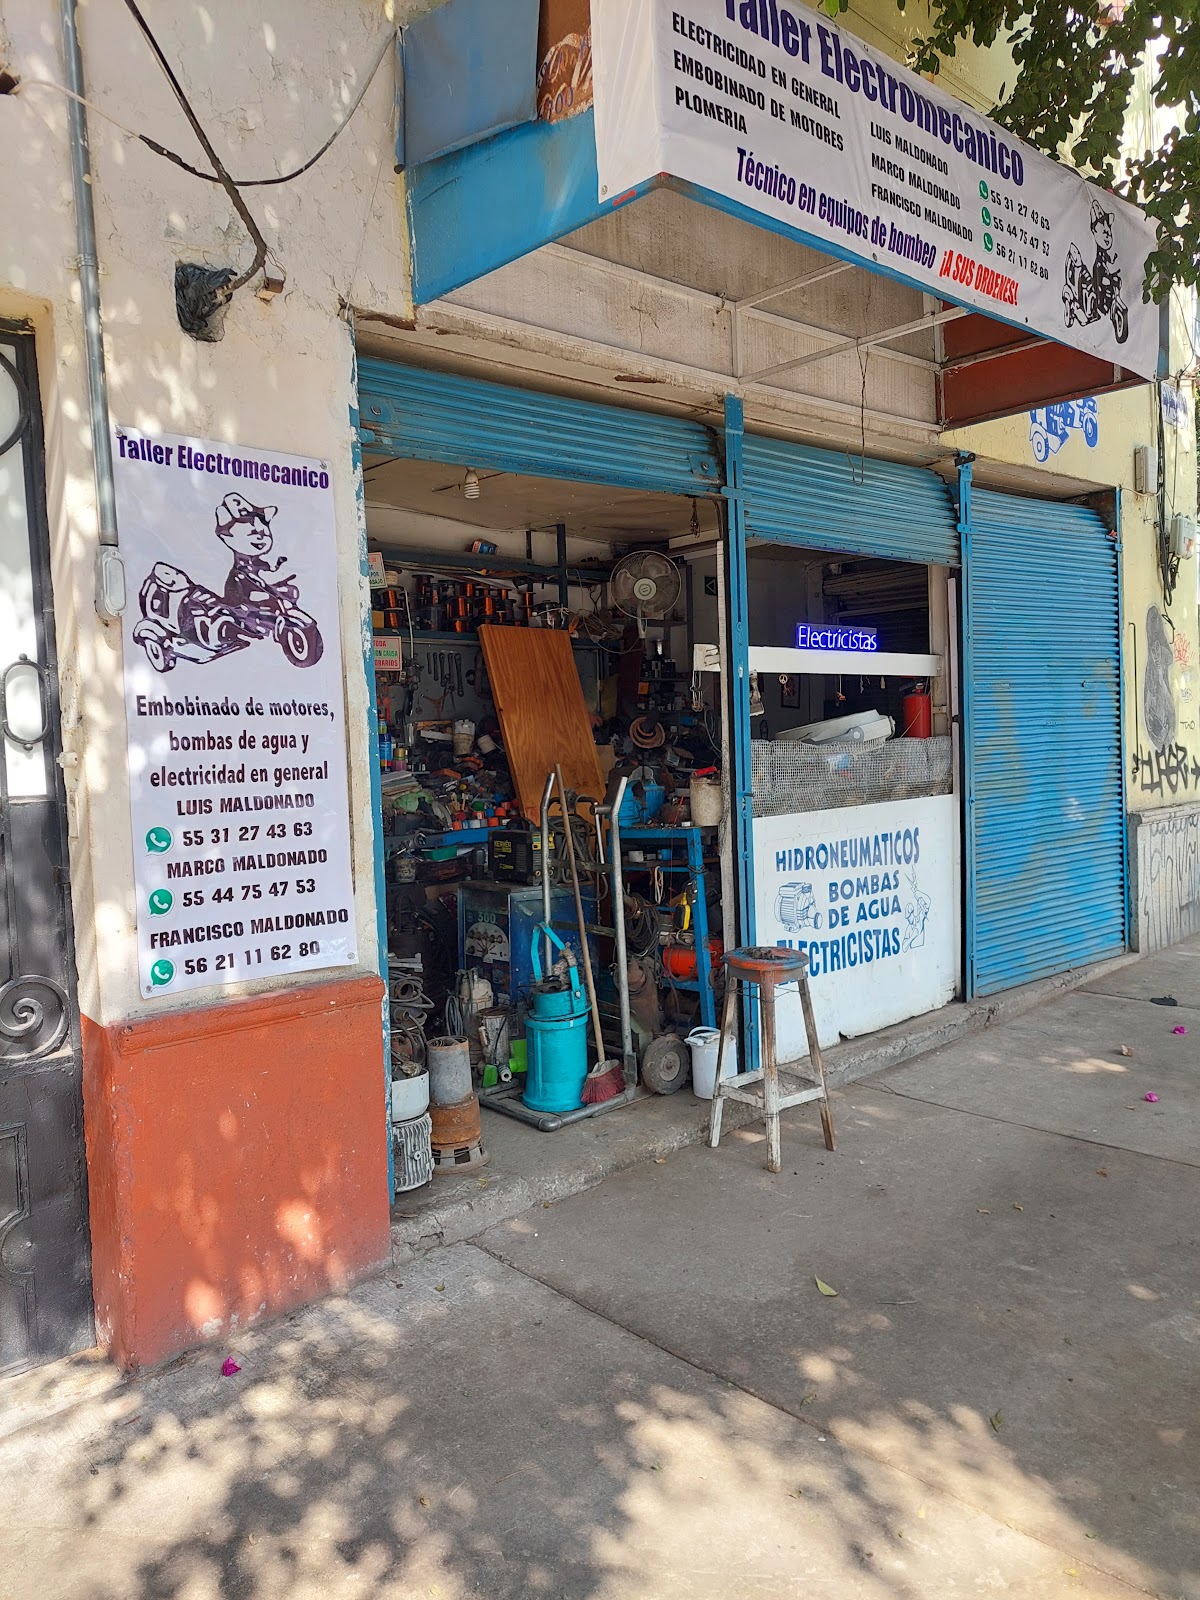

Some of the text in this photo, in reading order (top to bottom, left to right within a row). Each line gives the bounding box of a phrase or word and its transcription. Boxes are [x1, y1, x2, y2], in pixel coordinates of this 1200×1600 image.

[672, 11, 841, 119] ELECTRICIDAD EN GENERAL
[673, 49, 844, 151] EMBOBINADO DE MOTORES
[675, 85, 747, 134] PLOMERIA
[816, 22, 1024, 186] Electromecanico
[870, 121, 949, 176] LUIS MALDONADO
[871, 152, 961, 210] MARCO MALDONADO
[736, 147, 1020, 306] Técnico en equipos de bombeo ¡A SUS ORDENES!
[871, 183, 973, 242] FRANCISCO MALDONADO
[990, 190, 1050, 231] 55 31 27 43 63
[993, 216, 1050, 257] 55 44 75 47 53
[996, 242, 1049, 280] 56 21 11 62 80
[117, 435, 330, 489] Taller Electromecanico
[798, 625, 877, 651] Electricistas
[375, 659, 398, 667] ORARIOS
[136, 695, 335, 722] Embobinado de motores,
[169, 730, 309, 754] bombas de agua y
[150, 761, 328, 788] electricidad en general
[177, 793, 315, 816] LUIS MALDONADO
[183, 821, 313, 847] 55 31 27 43 63
[775, 826, 920, 872] HIDRONEUMATICOS
[167, 848, 328, 879] MARCO MALDONADO
[183, 878, 316, 907] 55 44 75 47 53
[829, 869, 900, 903] BOMBAS
[150, 908, 349, 950] FRANCISCO MALDONADO
[478, 911, 496, 924] 300
[828, 894, 902, 929] DE AGUA
[184, 940, 321, 975] 56 21 11 62 80
[776, 928, 901, 985] CTRICISTAS
